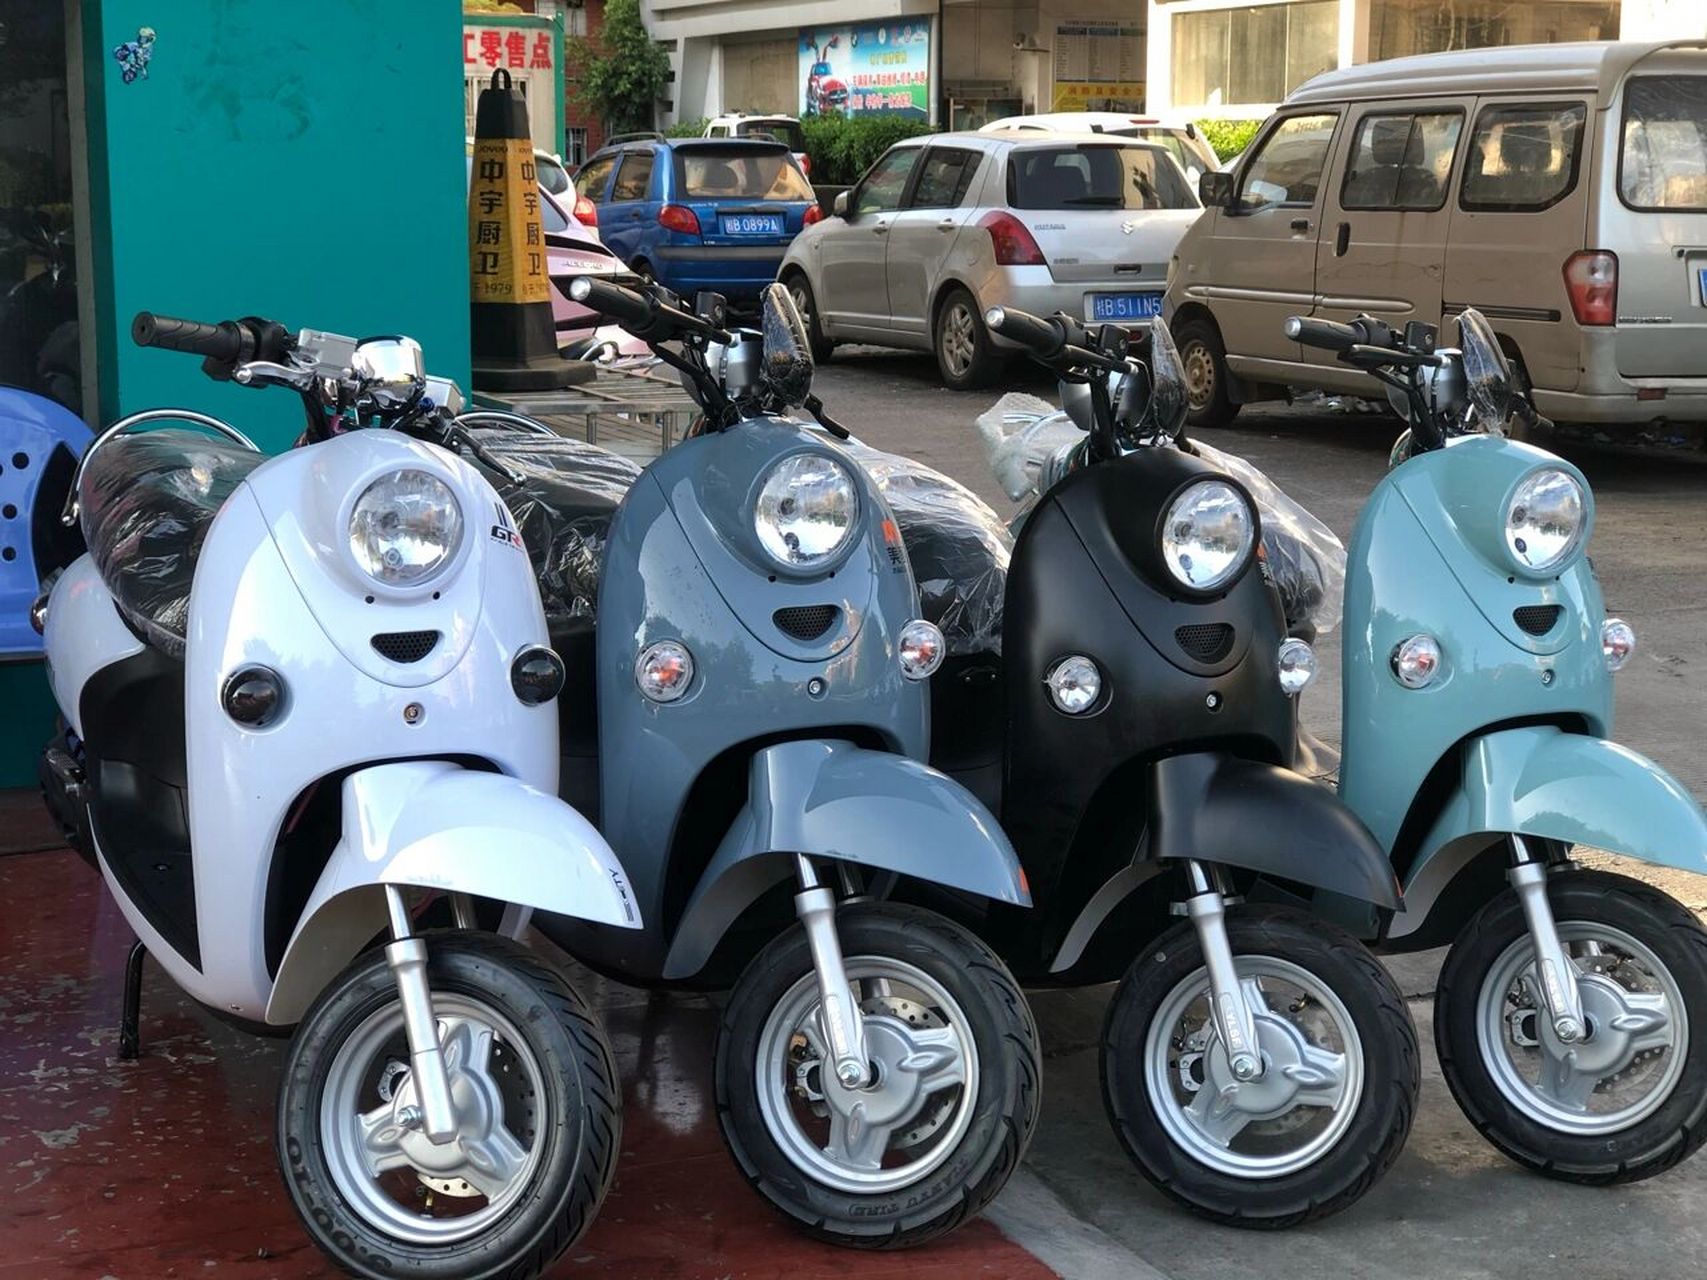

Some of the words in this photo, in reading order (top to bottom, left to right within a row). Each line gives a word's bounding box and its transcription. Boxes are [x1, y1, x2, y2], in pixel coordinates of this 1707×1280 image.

[474, 159, 504, 275] 中宇厨卫
[521, 160, 541, 276] 中宇厨卫
